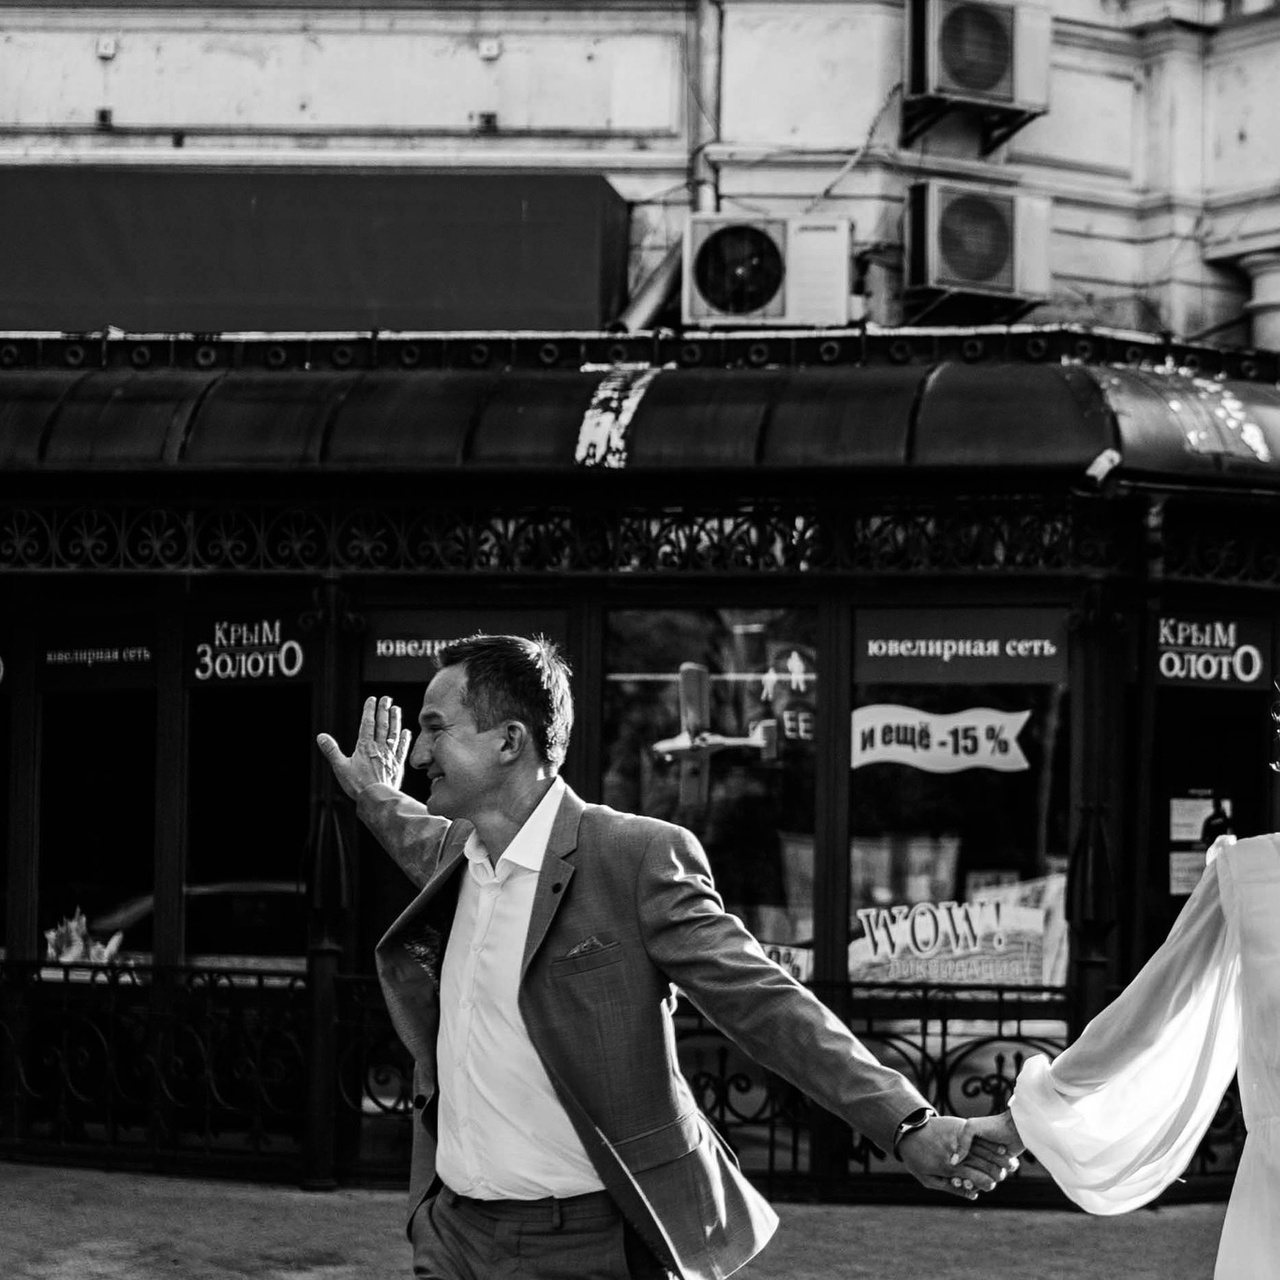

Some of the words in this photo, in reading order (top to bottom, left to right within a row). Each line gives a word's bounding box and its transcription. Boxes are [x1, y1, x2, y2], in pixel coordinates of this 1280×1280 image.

[122, 646, 151, 663] сеть
[867, 639, 998, 660] ювелирная
[1006, 638, 1056, 657] сеть
[861, 726, 875, 752] и
[881, 722, 930, 753] ещё
[857, 899, 1005, 958] WOW!
